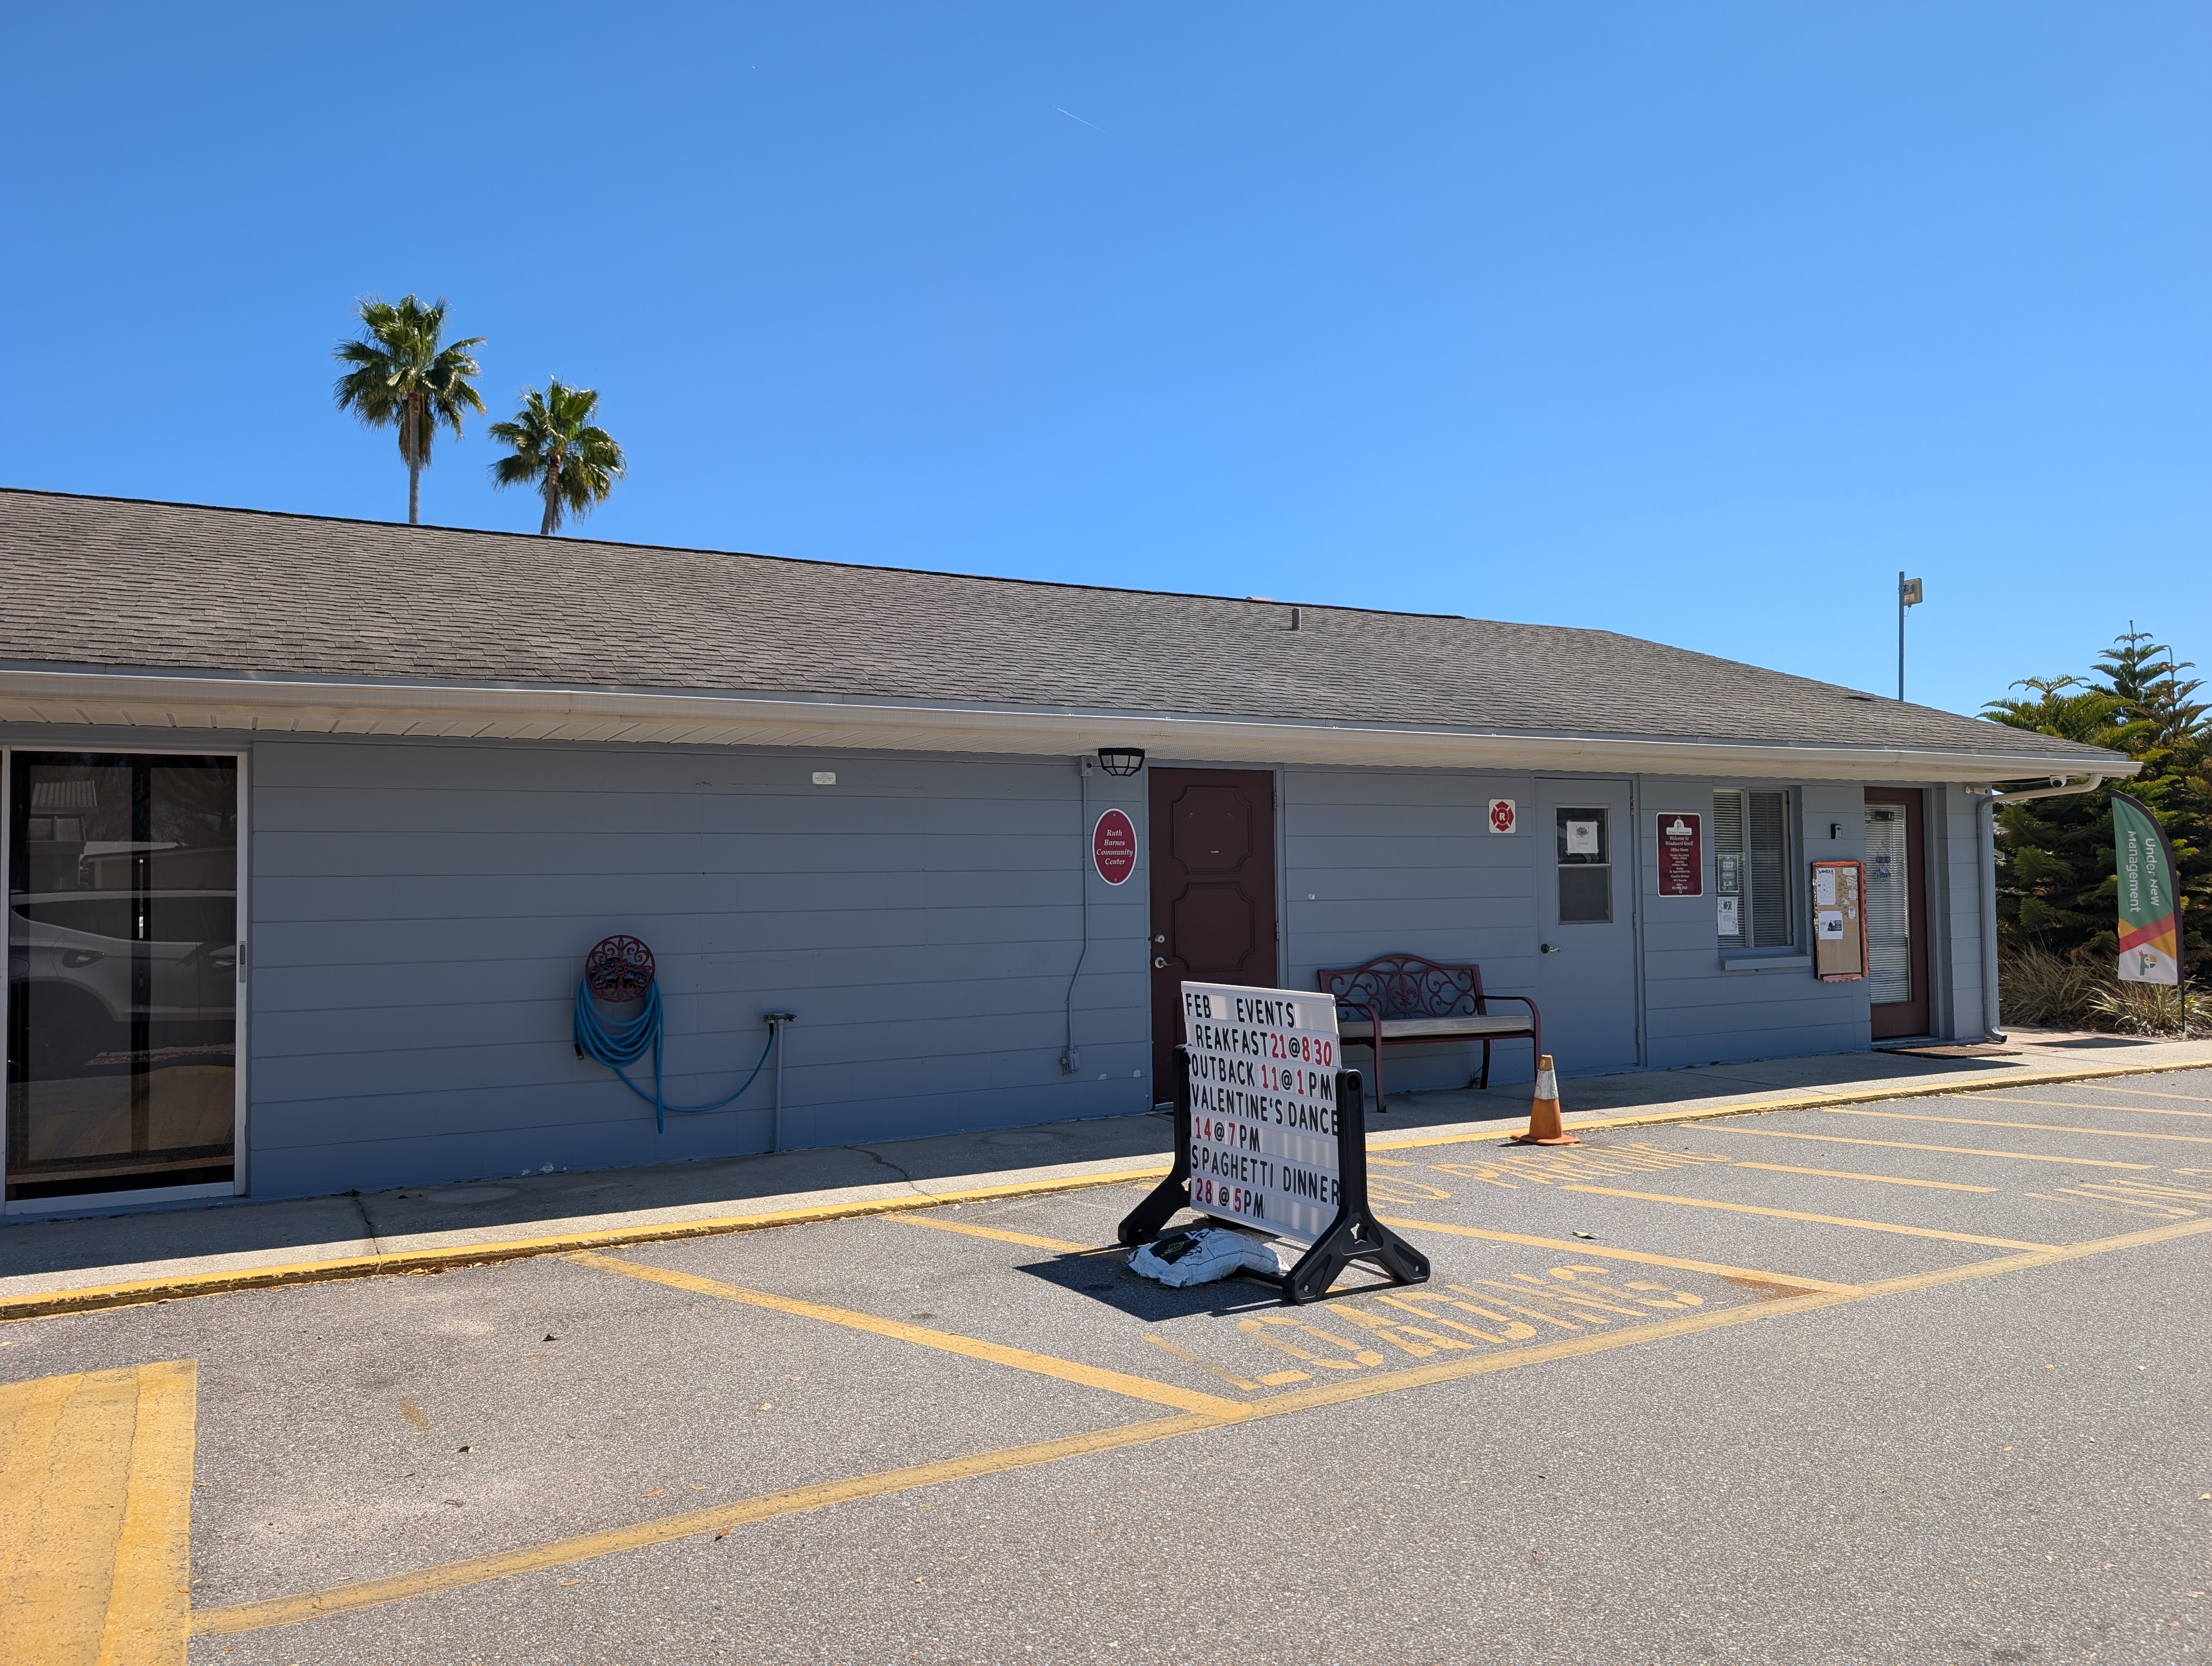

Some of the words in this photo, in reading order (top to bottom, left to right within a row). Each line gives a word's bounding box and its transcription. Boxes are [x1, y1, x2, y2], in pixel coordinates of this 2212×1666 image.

[1499, 812, 1506, 821] R
[1096, 848, 1133, 857] Community
[2145, 838, 2158, 876] Under
[2126, 830, 2140, 913] Management
[2150, 879, 2159, 907] New
[1186, 993, 1211, 1018] FEB
[1236, 998, 1295, 1028] EVENTS
[1195, 1024, 1268, 1057] REAKFAST
[1192, 1053, 1255, 1087] OUTBACK
[1192, 1083, 1283, 1124] VALENTINE'S
[1288, 1101, 1338, 1136] DANCE
[1192, 1144, 1274, 1188] SPAGHETTI
[1283, 1165, 1340, 1206] DINNER
[1428, 1143, 1732, 1189] PARKING
[1143, 1264, 1704, 1391] LOADING
